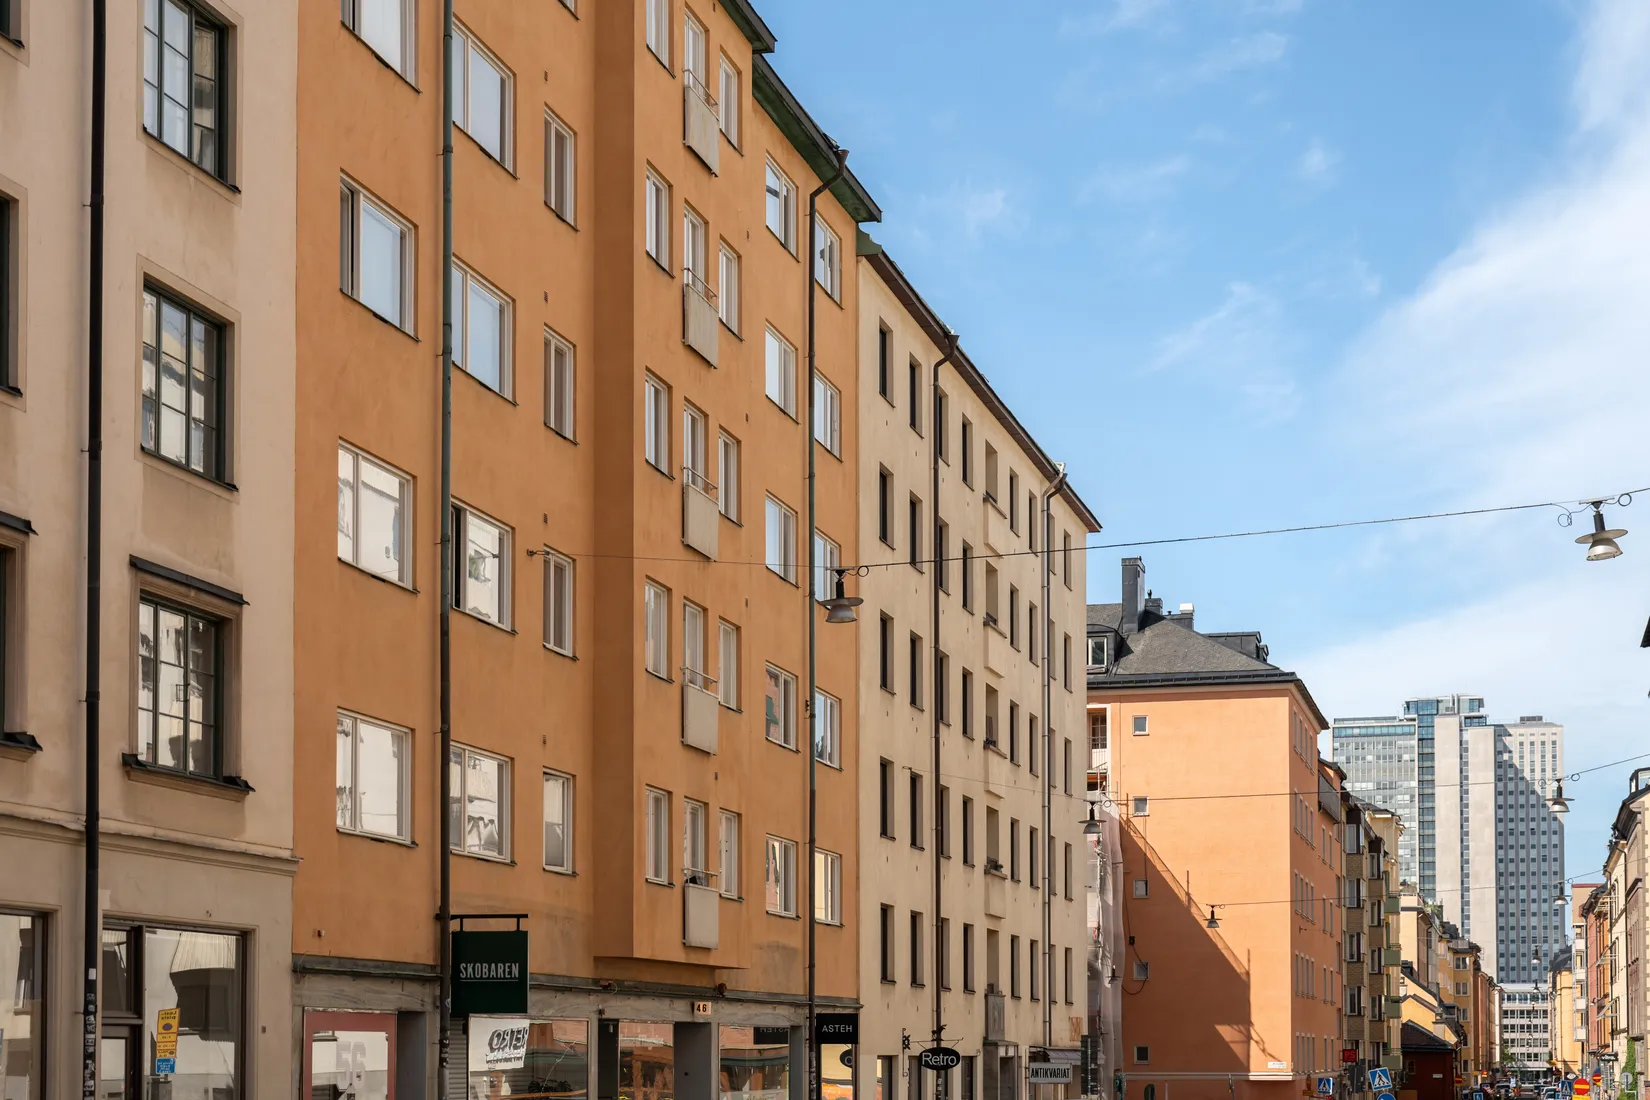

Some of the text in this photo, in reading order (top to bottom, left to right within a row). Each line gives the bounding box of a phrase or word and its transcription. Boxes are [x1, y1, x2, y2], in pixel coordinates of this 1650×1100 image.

[460, 962, 519, 979] SKOBAREN
[696, 1003, 707, 1013] 46
[821, 1024, 853, 1033] ASTEH
[922, 1052, 957, 1066] Retro
[1030, 1067, 1071, 1079] ANTIKVARIAT
